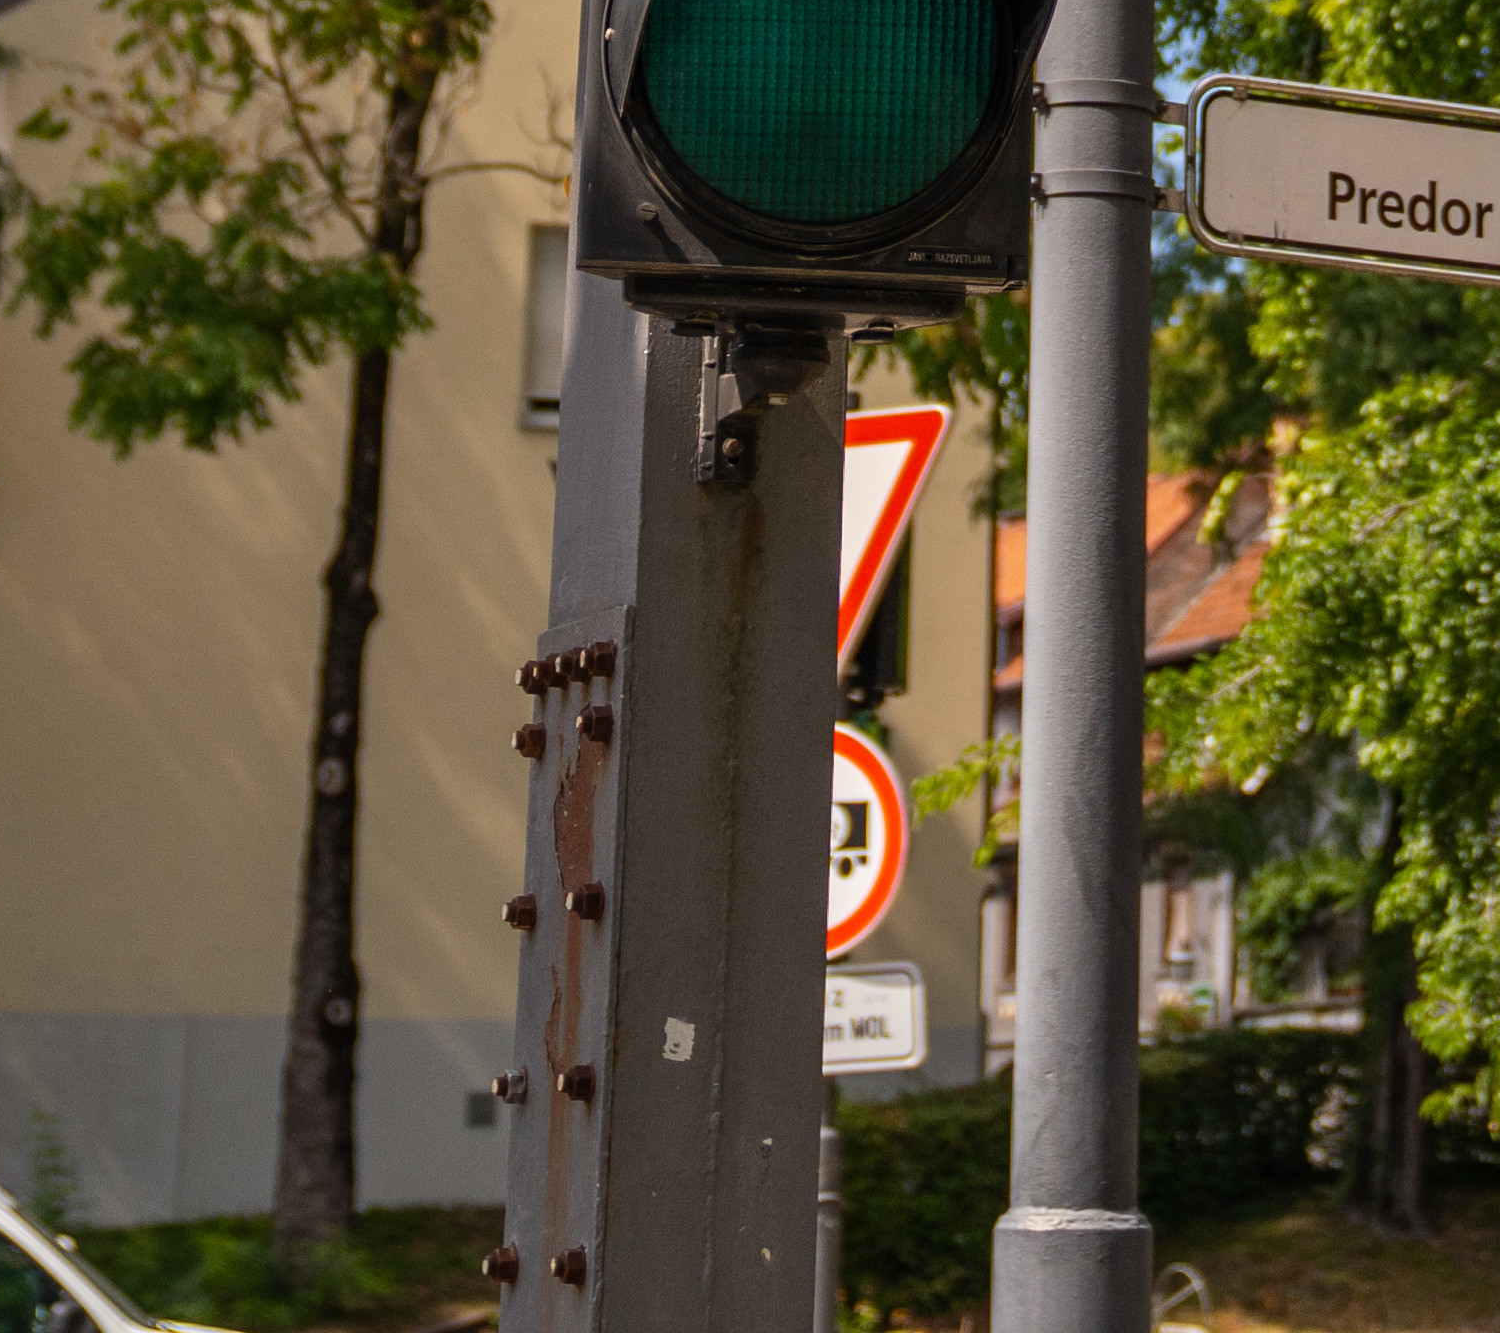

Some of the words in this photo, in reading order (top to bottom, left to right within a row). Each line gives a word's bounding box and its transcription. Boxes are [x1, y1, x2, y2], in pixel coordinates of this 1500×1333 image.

[1328, 171, 1493, 239] Predor
[908, 252, 933, 262] JAV
[935, 253, 992, 264] RAZSVETLJAVA
